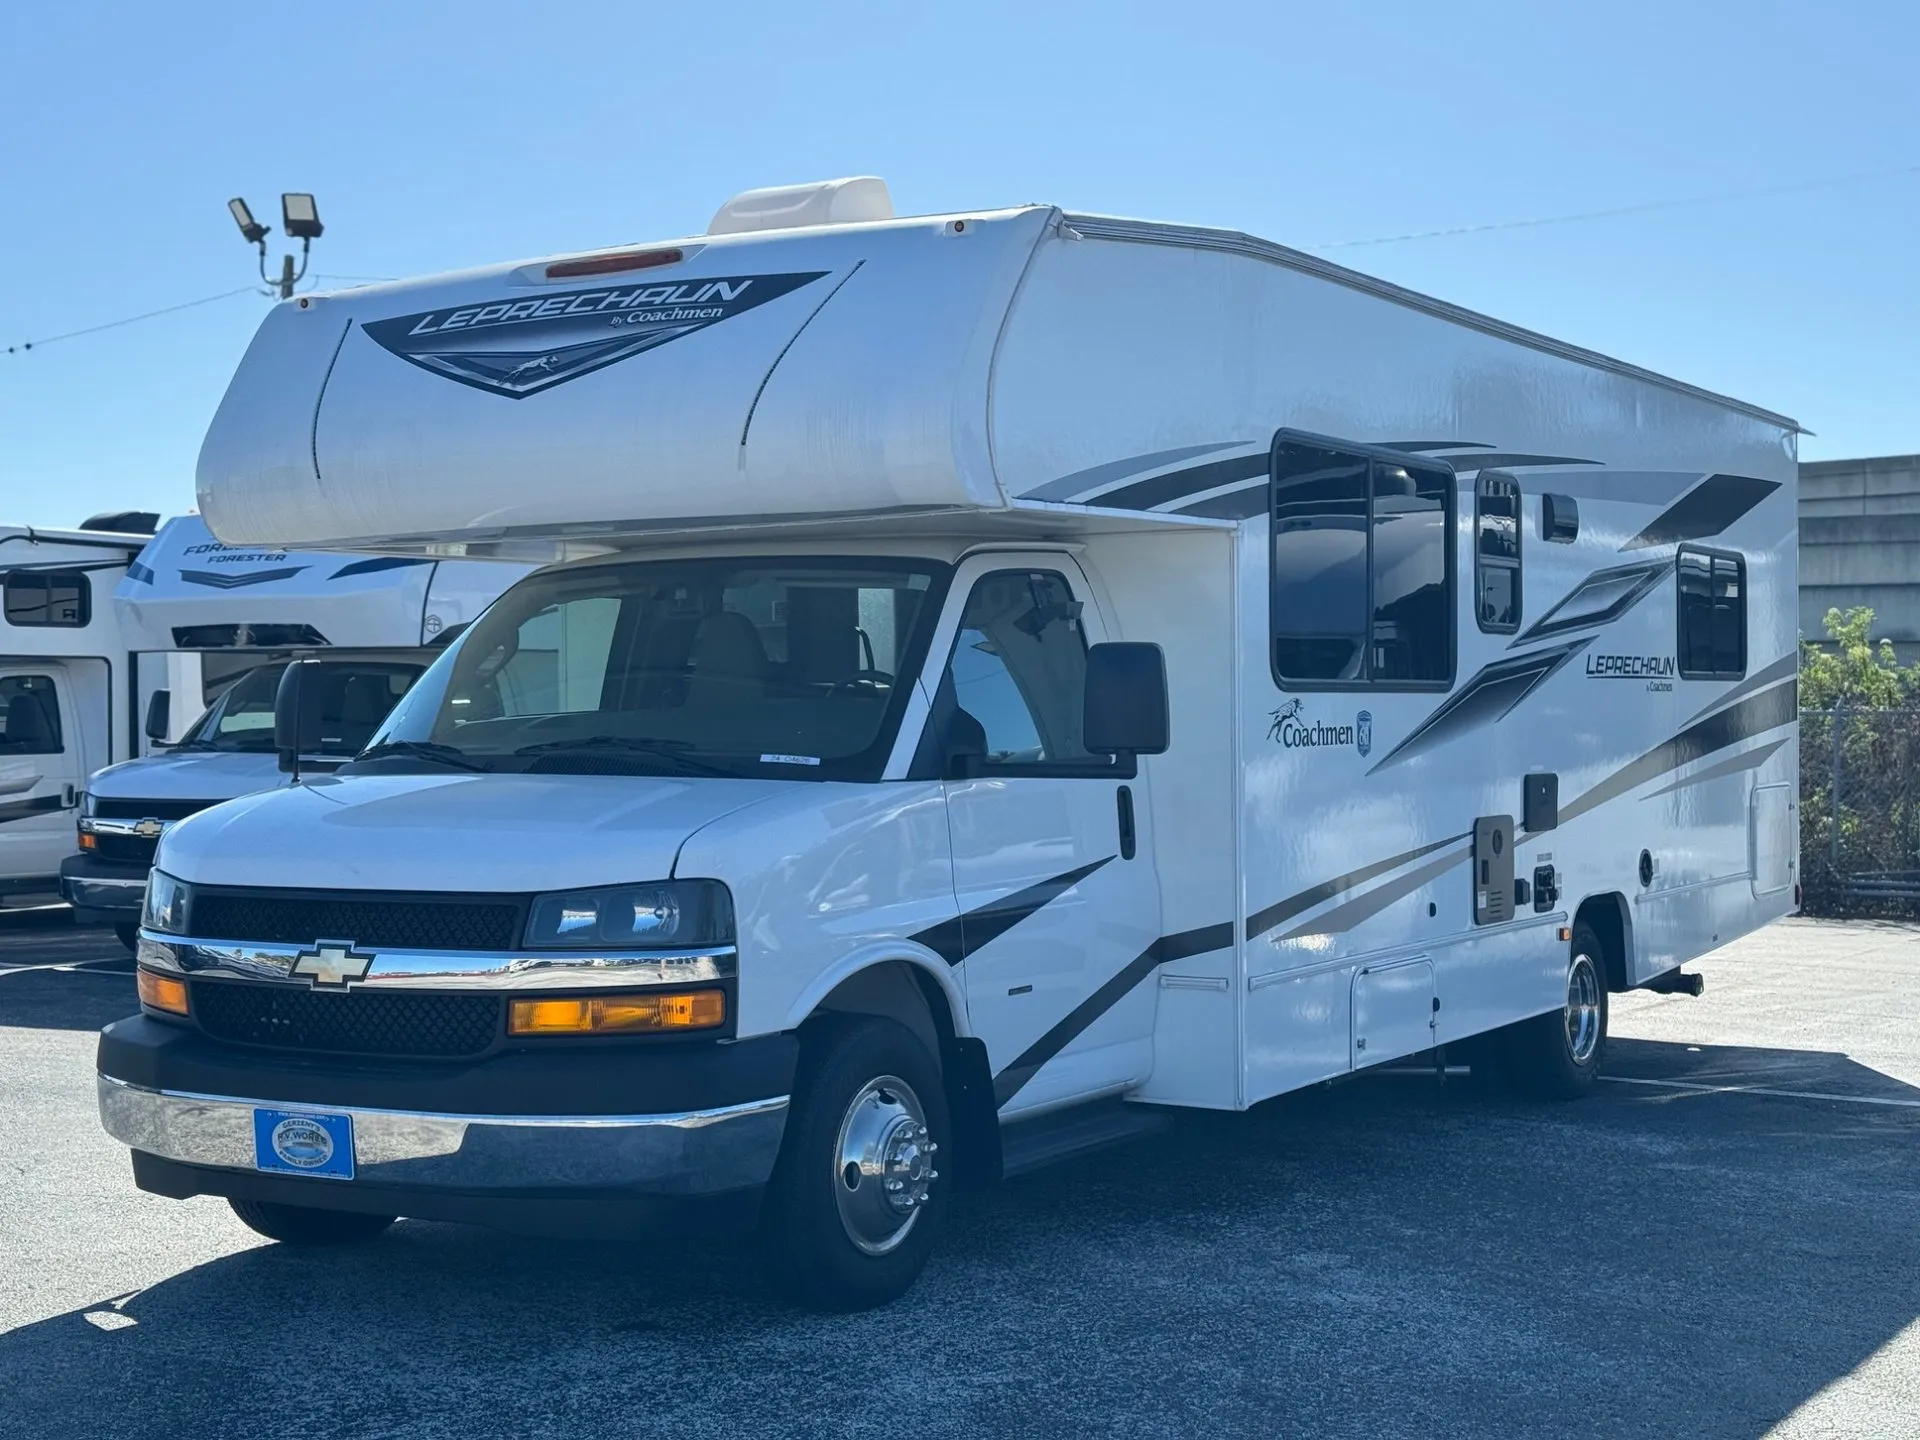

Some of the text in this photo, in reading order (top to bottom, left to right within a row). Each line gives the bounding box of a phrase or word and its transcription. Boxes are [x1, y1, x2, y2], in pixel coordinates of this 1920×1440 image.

[408, 280, 753, 336] LEPRECHAUN
[610, 305, 723, 328] By Coachmen
[207, 553, 287, 564] FORESTER
[1586, 654, 1675, 675] LEPRECHAUN
[1283, 720, 1354, 748] Coachmen
[279, 1150, 328, 1166] FAMILY OWNED
